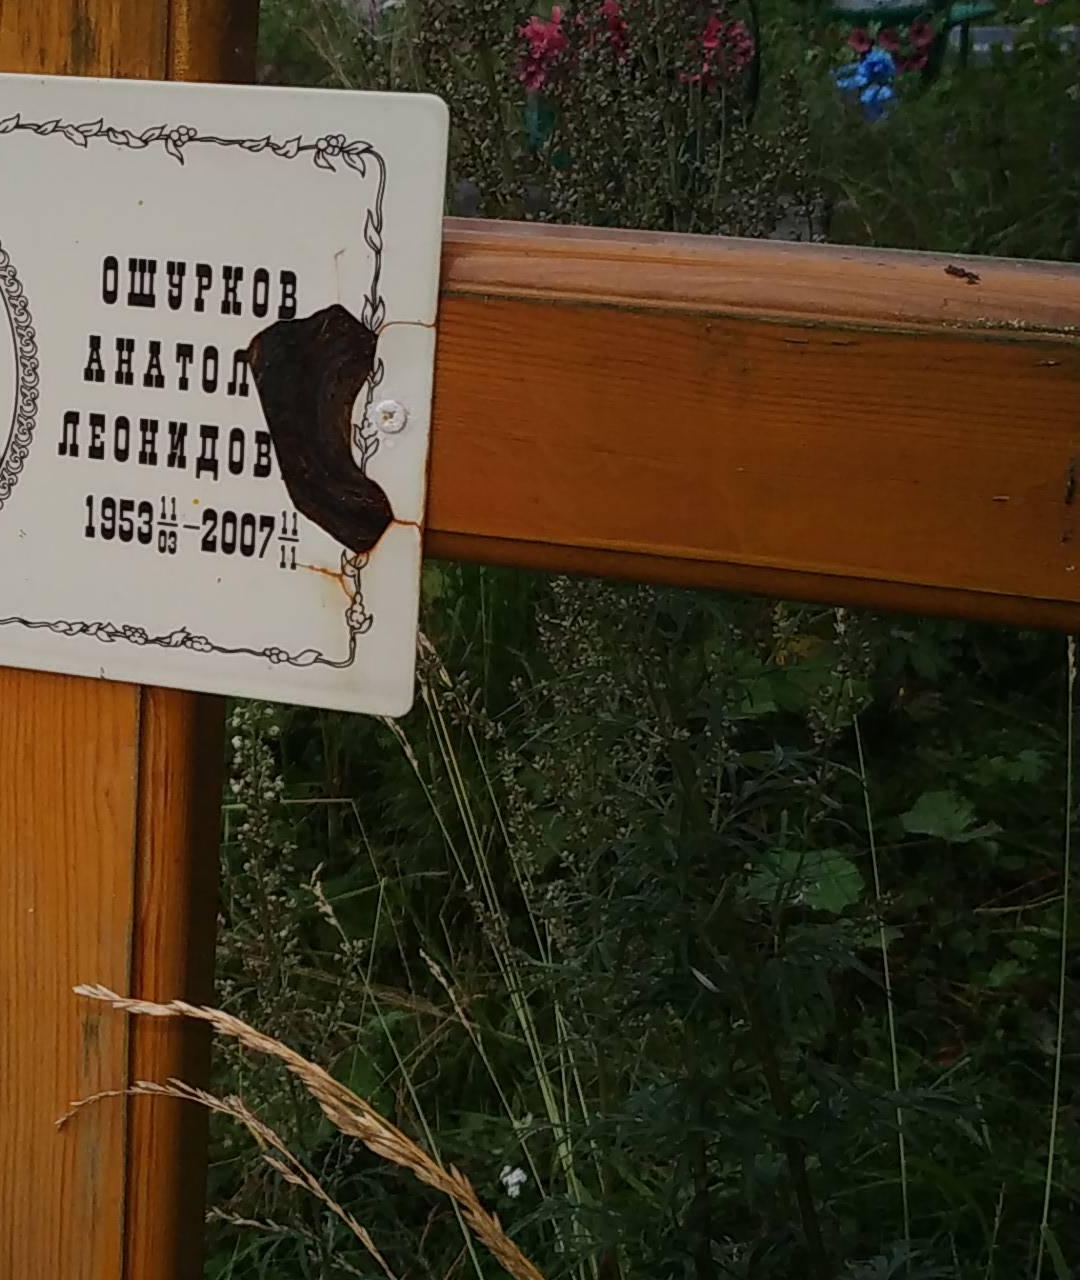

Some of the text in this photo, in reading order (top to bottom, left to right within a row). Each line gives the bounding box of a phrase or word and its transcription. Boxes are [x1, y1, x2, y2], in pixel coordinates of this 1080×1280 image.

[102, 255, 297, 320] ОШУРКОВ
[83, 334, 250, 397] АНАТОЛ
[57, 410, 274, 481] ЛЕОНИДОВ
[85, 494, 153, 545] 1953
